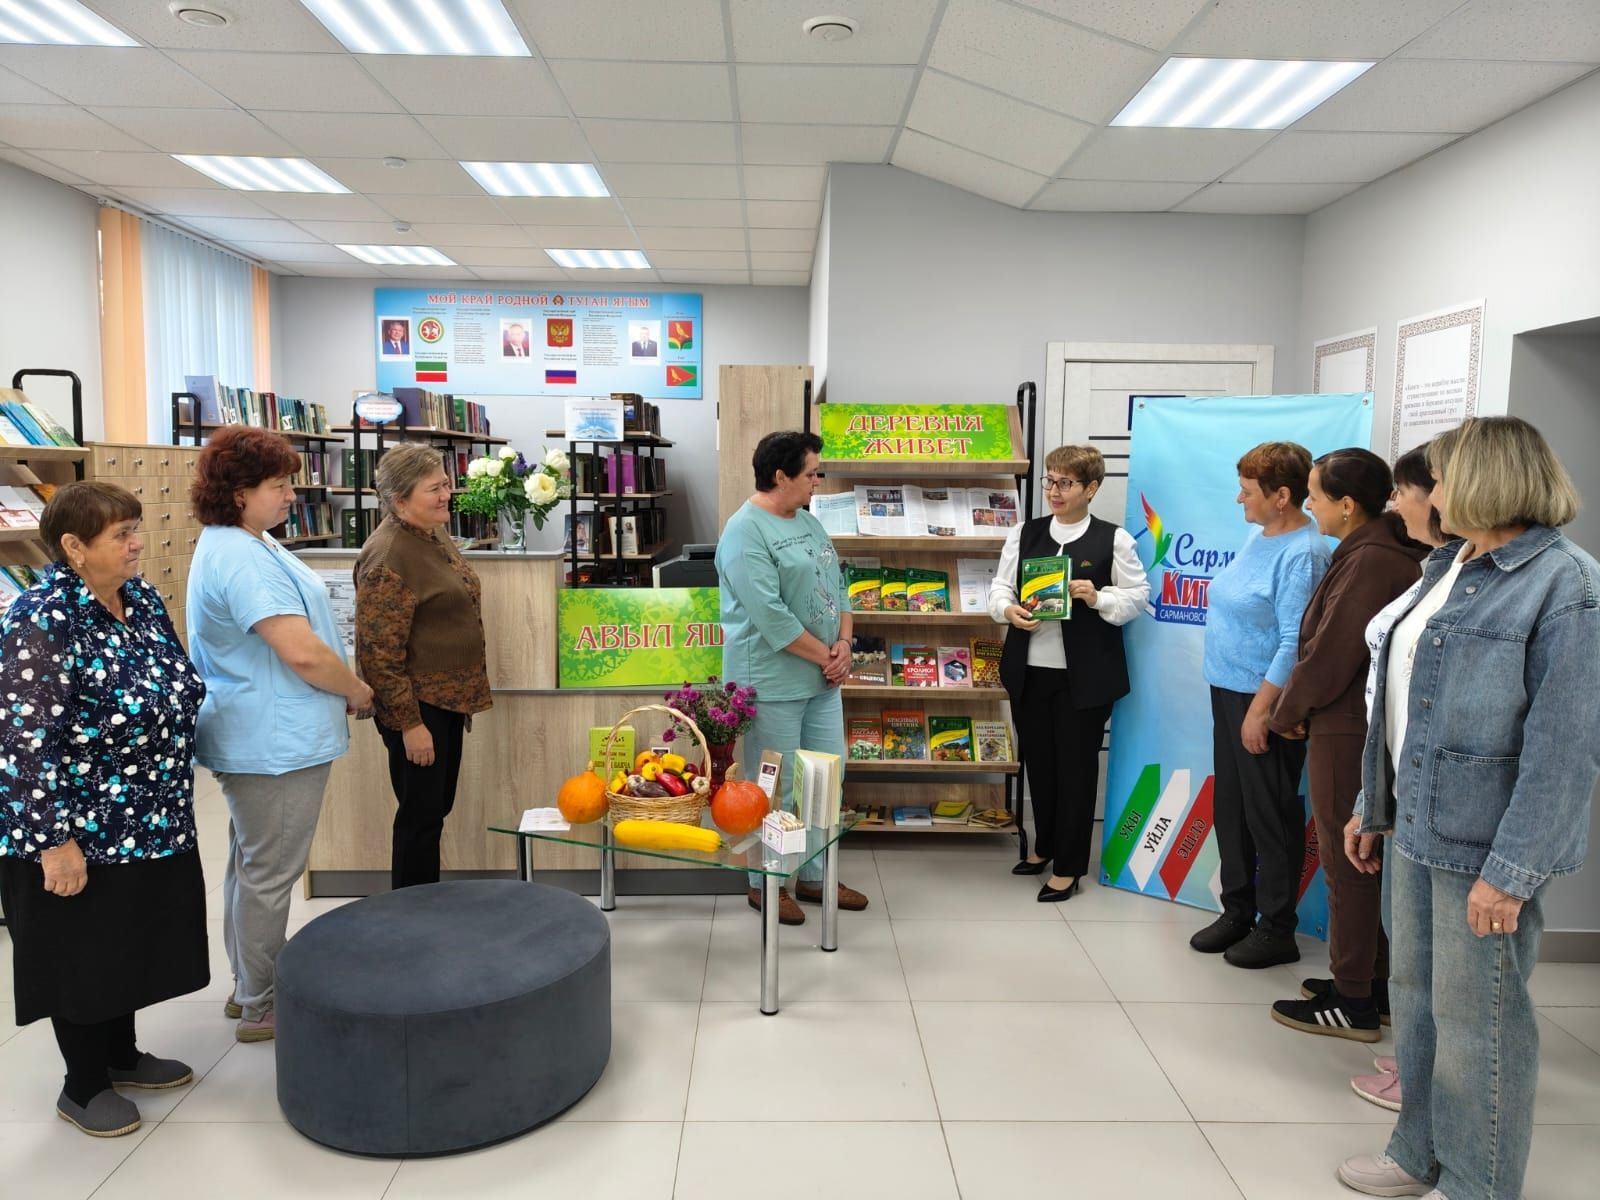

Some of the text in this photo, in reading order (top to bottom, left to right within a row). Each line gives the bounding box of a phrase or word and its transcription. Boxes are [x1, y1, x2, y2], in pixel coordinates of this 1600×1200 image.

[428, 292, 457, 304] МОЙ
[461, 293, 493, 304] КРАЙ
[497, 294, 548, 306] РОДНОЙ
[846, 415, 983, 433] ДЕРЕВНЯ
[864, 437, 972, 455] ЖИВЕТ
[574, 623, 672, 651] АВЫЛ
[1120, 810, 1141, 839] УКЫ
[1144, 817, 1172, 853] УЙЛА
